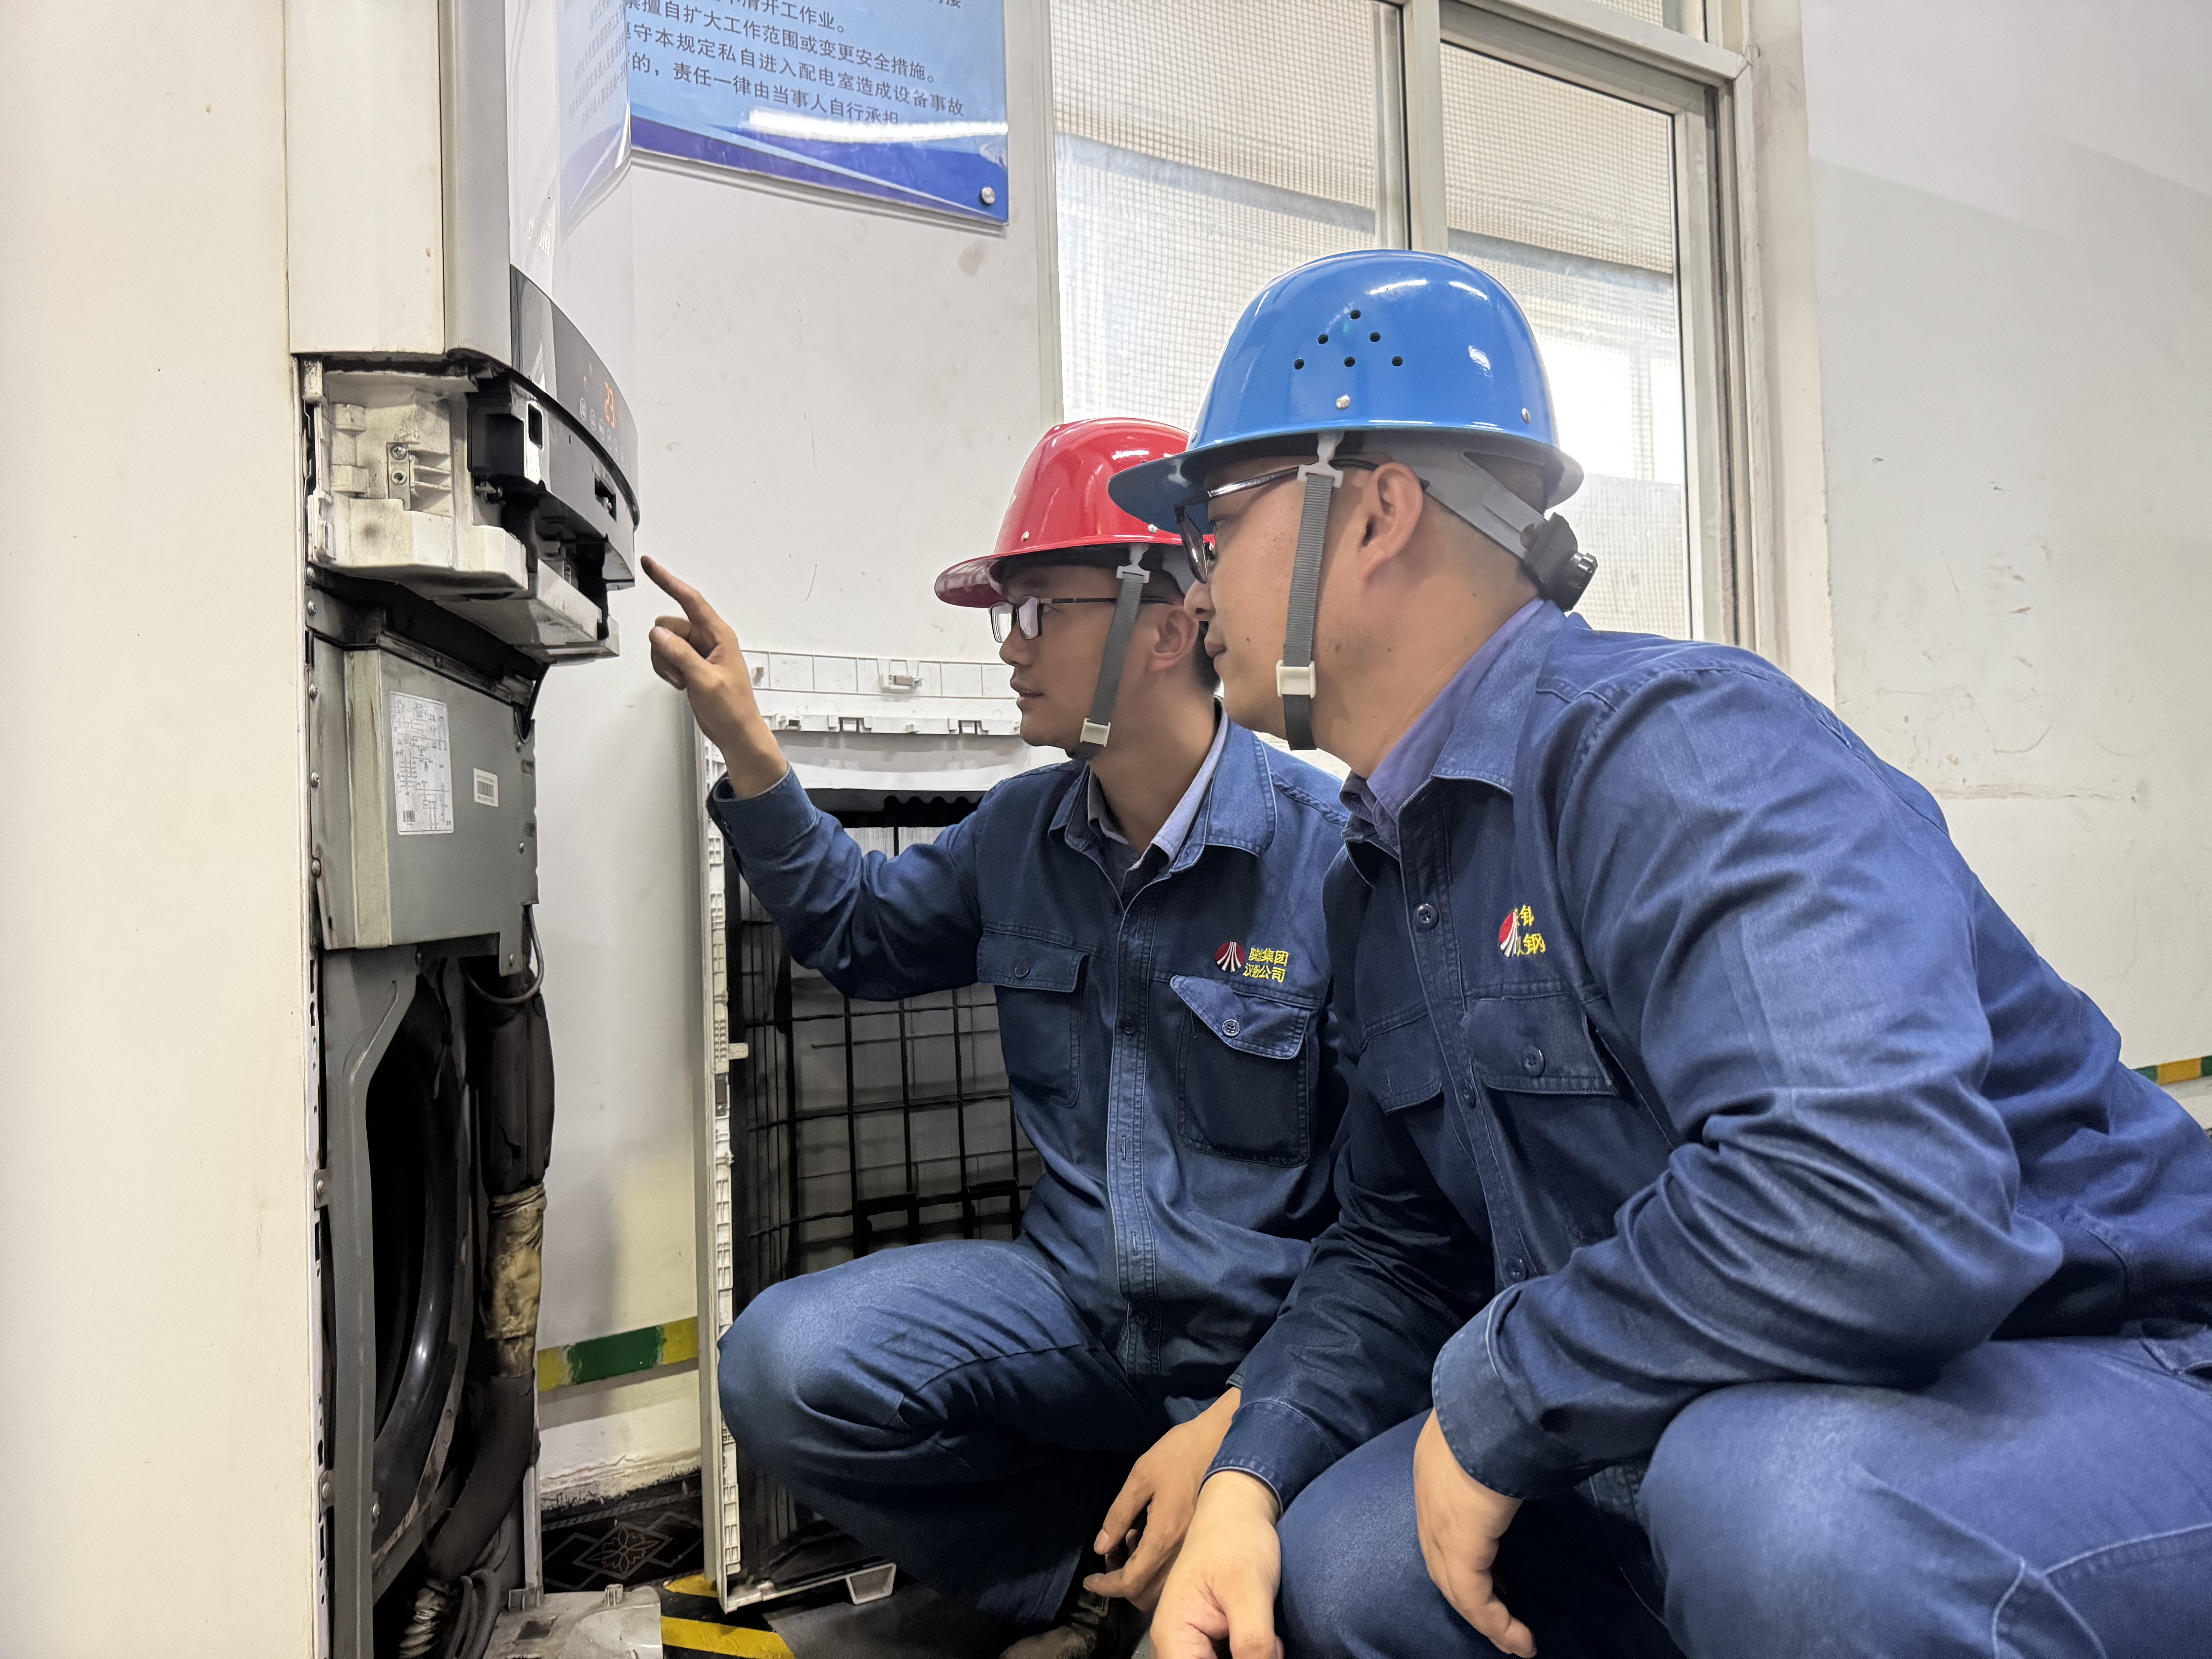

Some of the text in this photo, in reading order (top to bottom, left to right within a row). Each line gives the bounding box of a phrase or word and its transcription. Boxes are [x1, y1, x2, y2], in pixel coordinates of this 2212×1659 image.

[627, 22, 963, 116] 守本规定私自进入配电室造成设备事故
[627, 51, 898, 124] 的，责任一律由当事人自行承担
